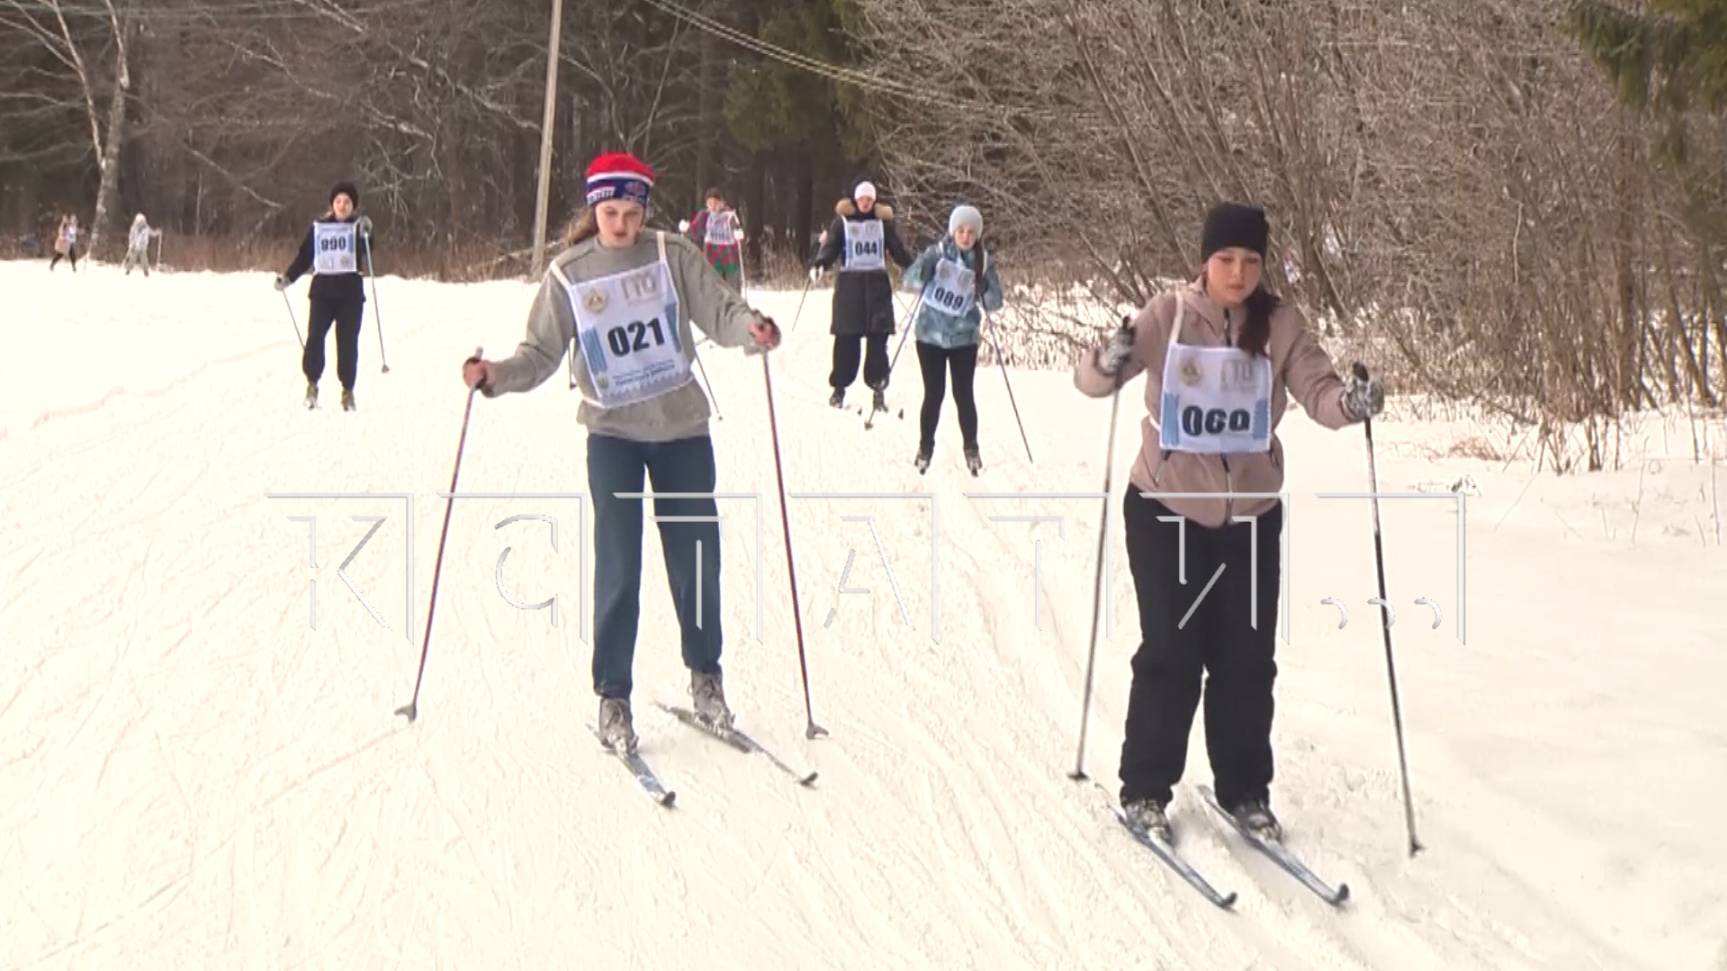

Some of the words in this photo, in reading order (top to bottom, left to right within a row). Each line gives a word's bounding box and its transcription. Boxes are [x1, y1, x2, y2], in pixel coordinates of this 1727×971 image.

[855, 240, 877, 256] 044
[934, 287, 964, 311] 089
[607, 317, 665, 357] 021
